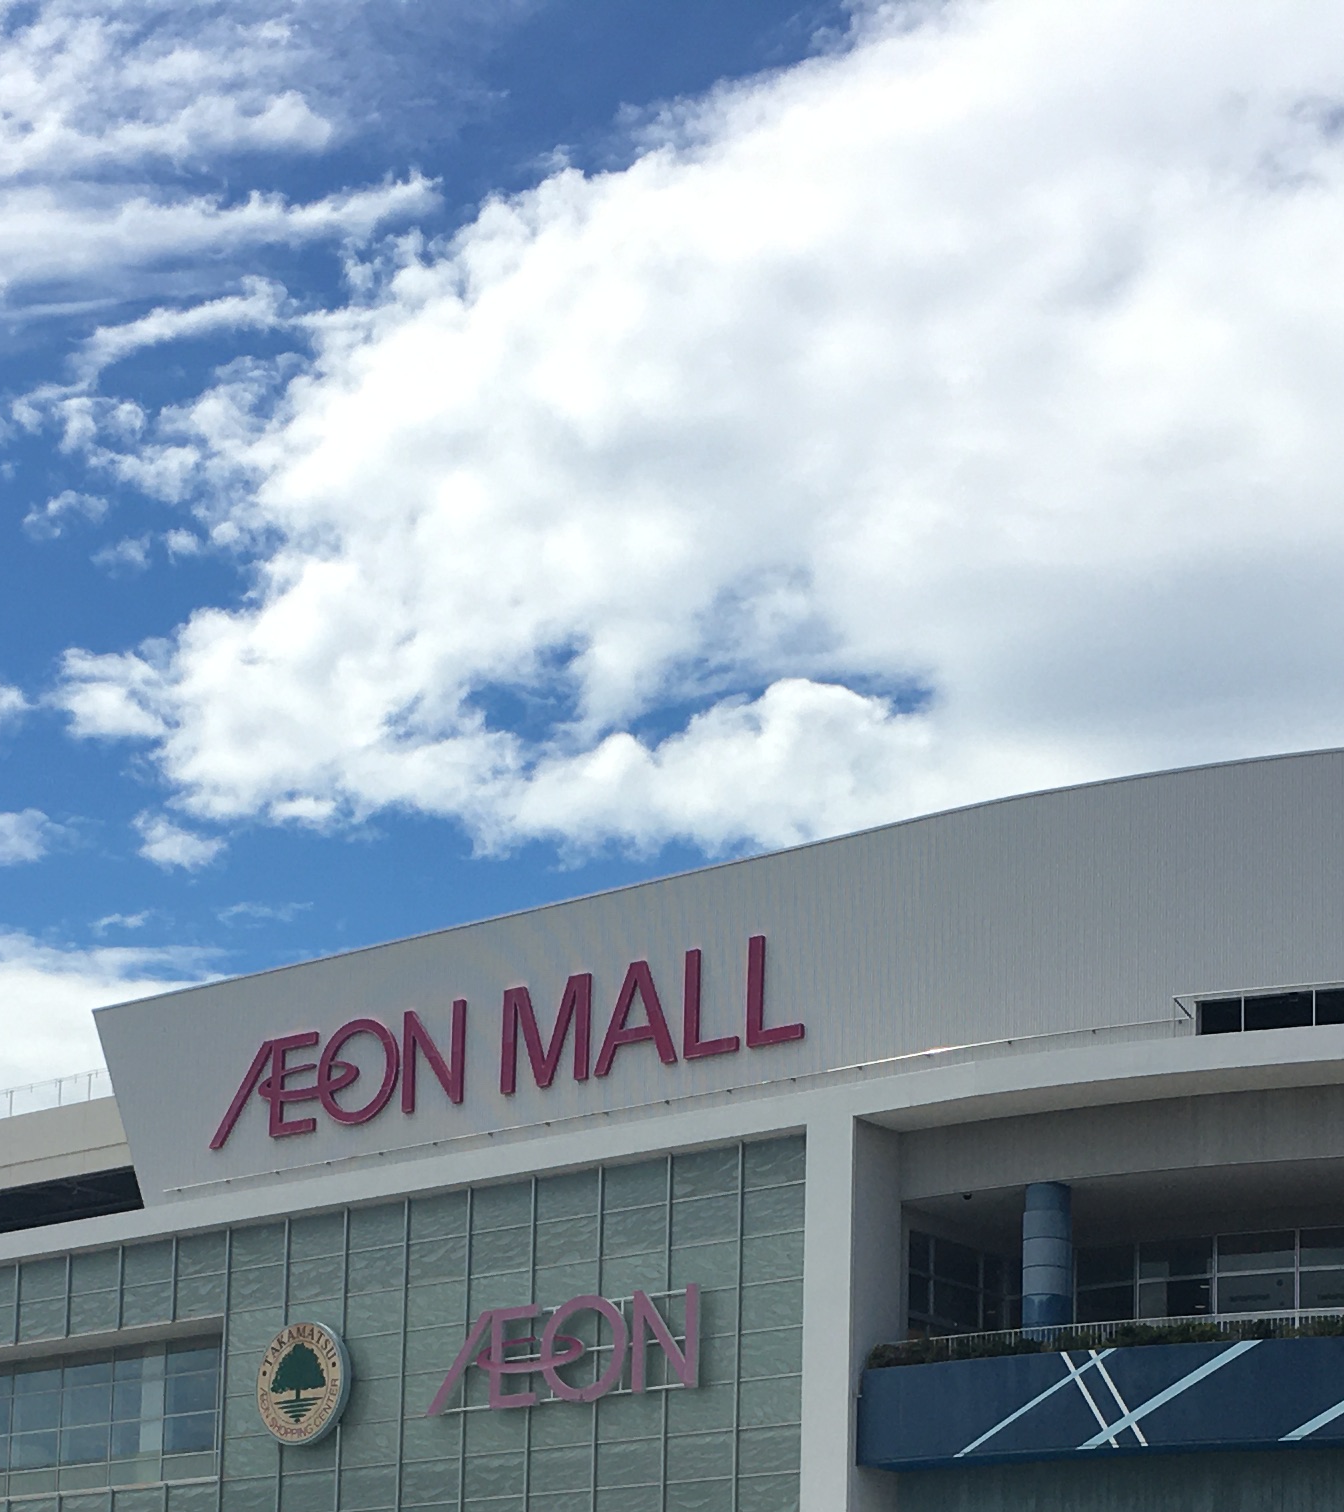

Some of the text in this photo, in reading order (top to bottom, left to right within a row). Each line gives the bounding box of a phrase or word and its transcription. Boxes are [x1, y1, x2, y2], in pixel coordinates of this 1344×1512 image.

[500, 935, 805, 1095] MALL
[264, 1325, 337, 1367] TAKAMATSU
[269, 1417, 314, 1438] SHOPPING
[313, 1378, 339, 1428] CENTER
